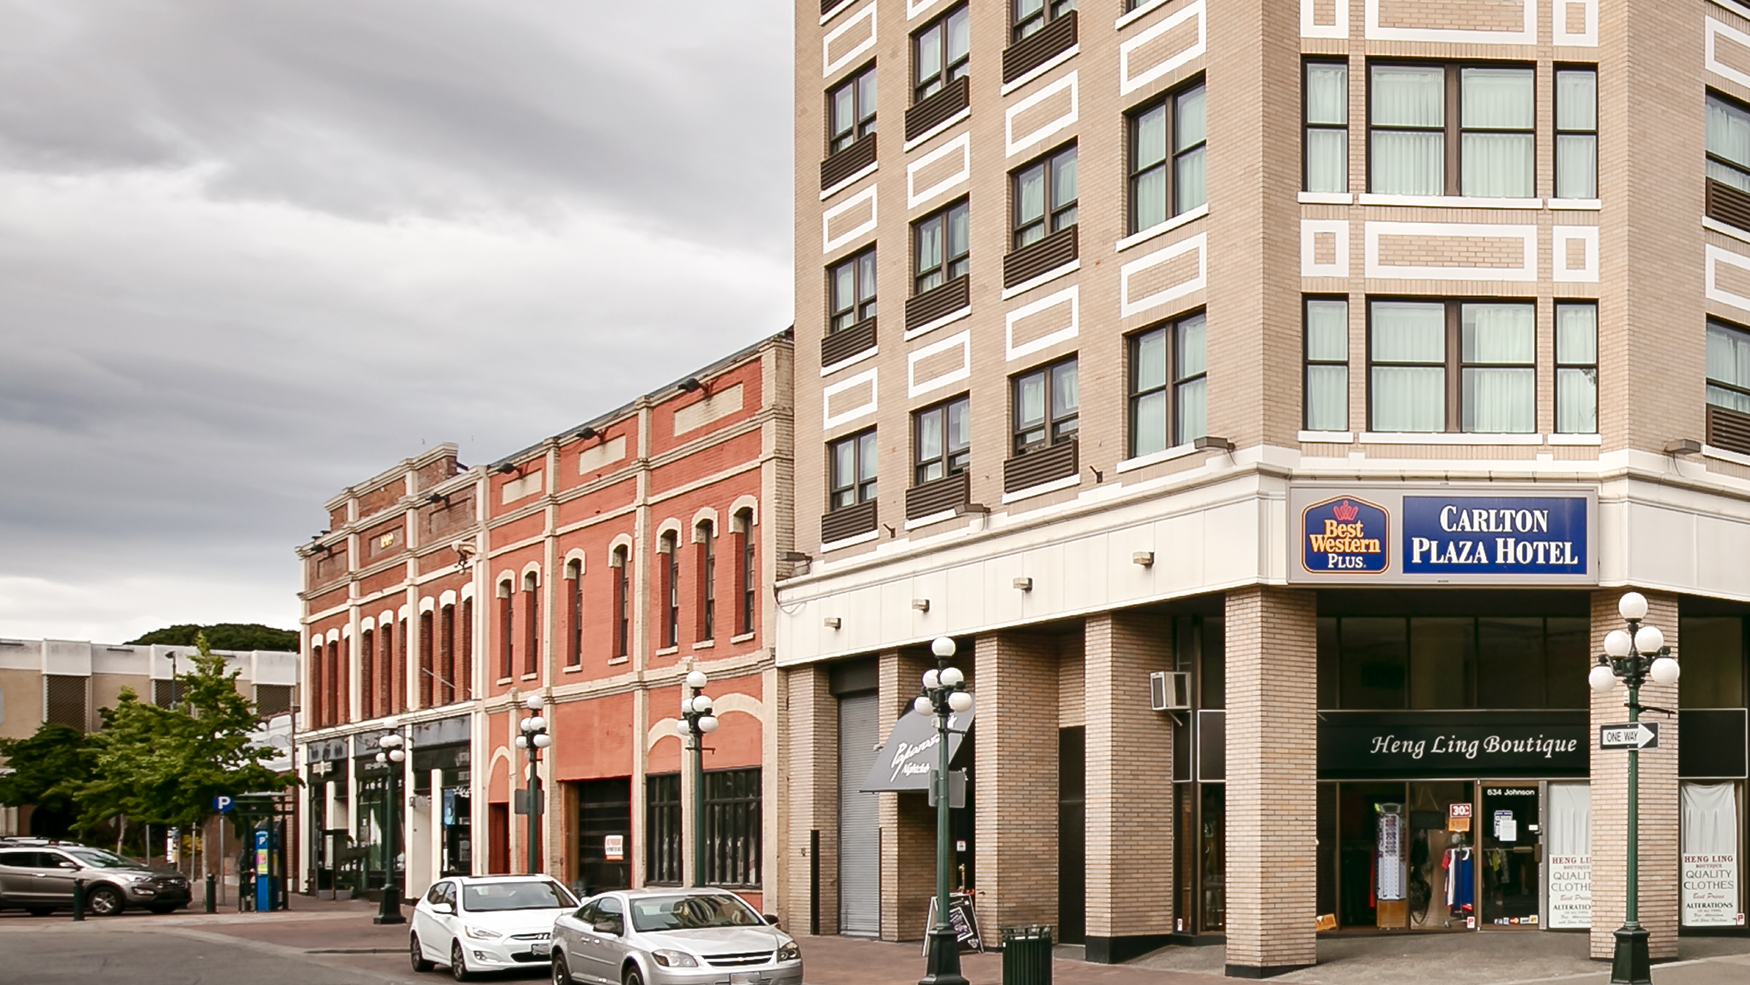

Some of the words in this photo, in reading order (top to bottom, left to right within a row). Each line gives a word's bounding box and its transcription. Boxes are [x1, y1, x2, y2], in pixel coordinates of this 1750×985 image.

[1439, 505, 1549, 533] CARLTON
[1323, 519, 1364, 538] Best
[1309, 534, 1382, 554] Western
[1411, 537, 1489, 564] PLAZA
[1495, 537, 1579, 565] HOTEL
[1327, 553, 1364, 569] PLUS
[1606, 731, 1621, 743] ONE
[1623, 730, 1639, 742] WAY
[1370, 735, 1424, 759] Heng
[1431, 736, 1479, 759] Ling
[1483, 735, 1577, 758] Boutique
[1504, 788, 1535, 796] Johnson
[218, 796, 231, 809] P
[1712, 855, 1734, 863] LING
[1553, 871, 1591, 880] QUALIT
[1685, 870, 1732, 879] QUALITY
[1551, 882, 1592, 892] CLOTHE
[1683, 881, 1734, 890] CLOTHES
